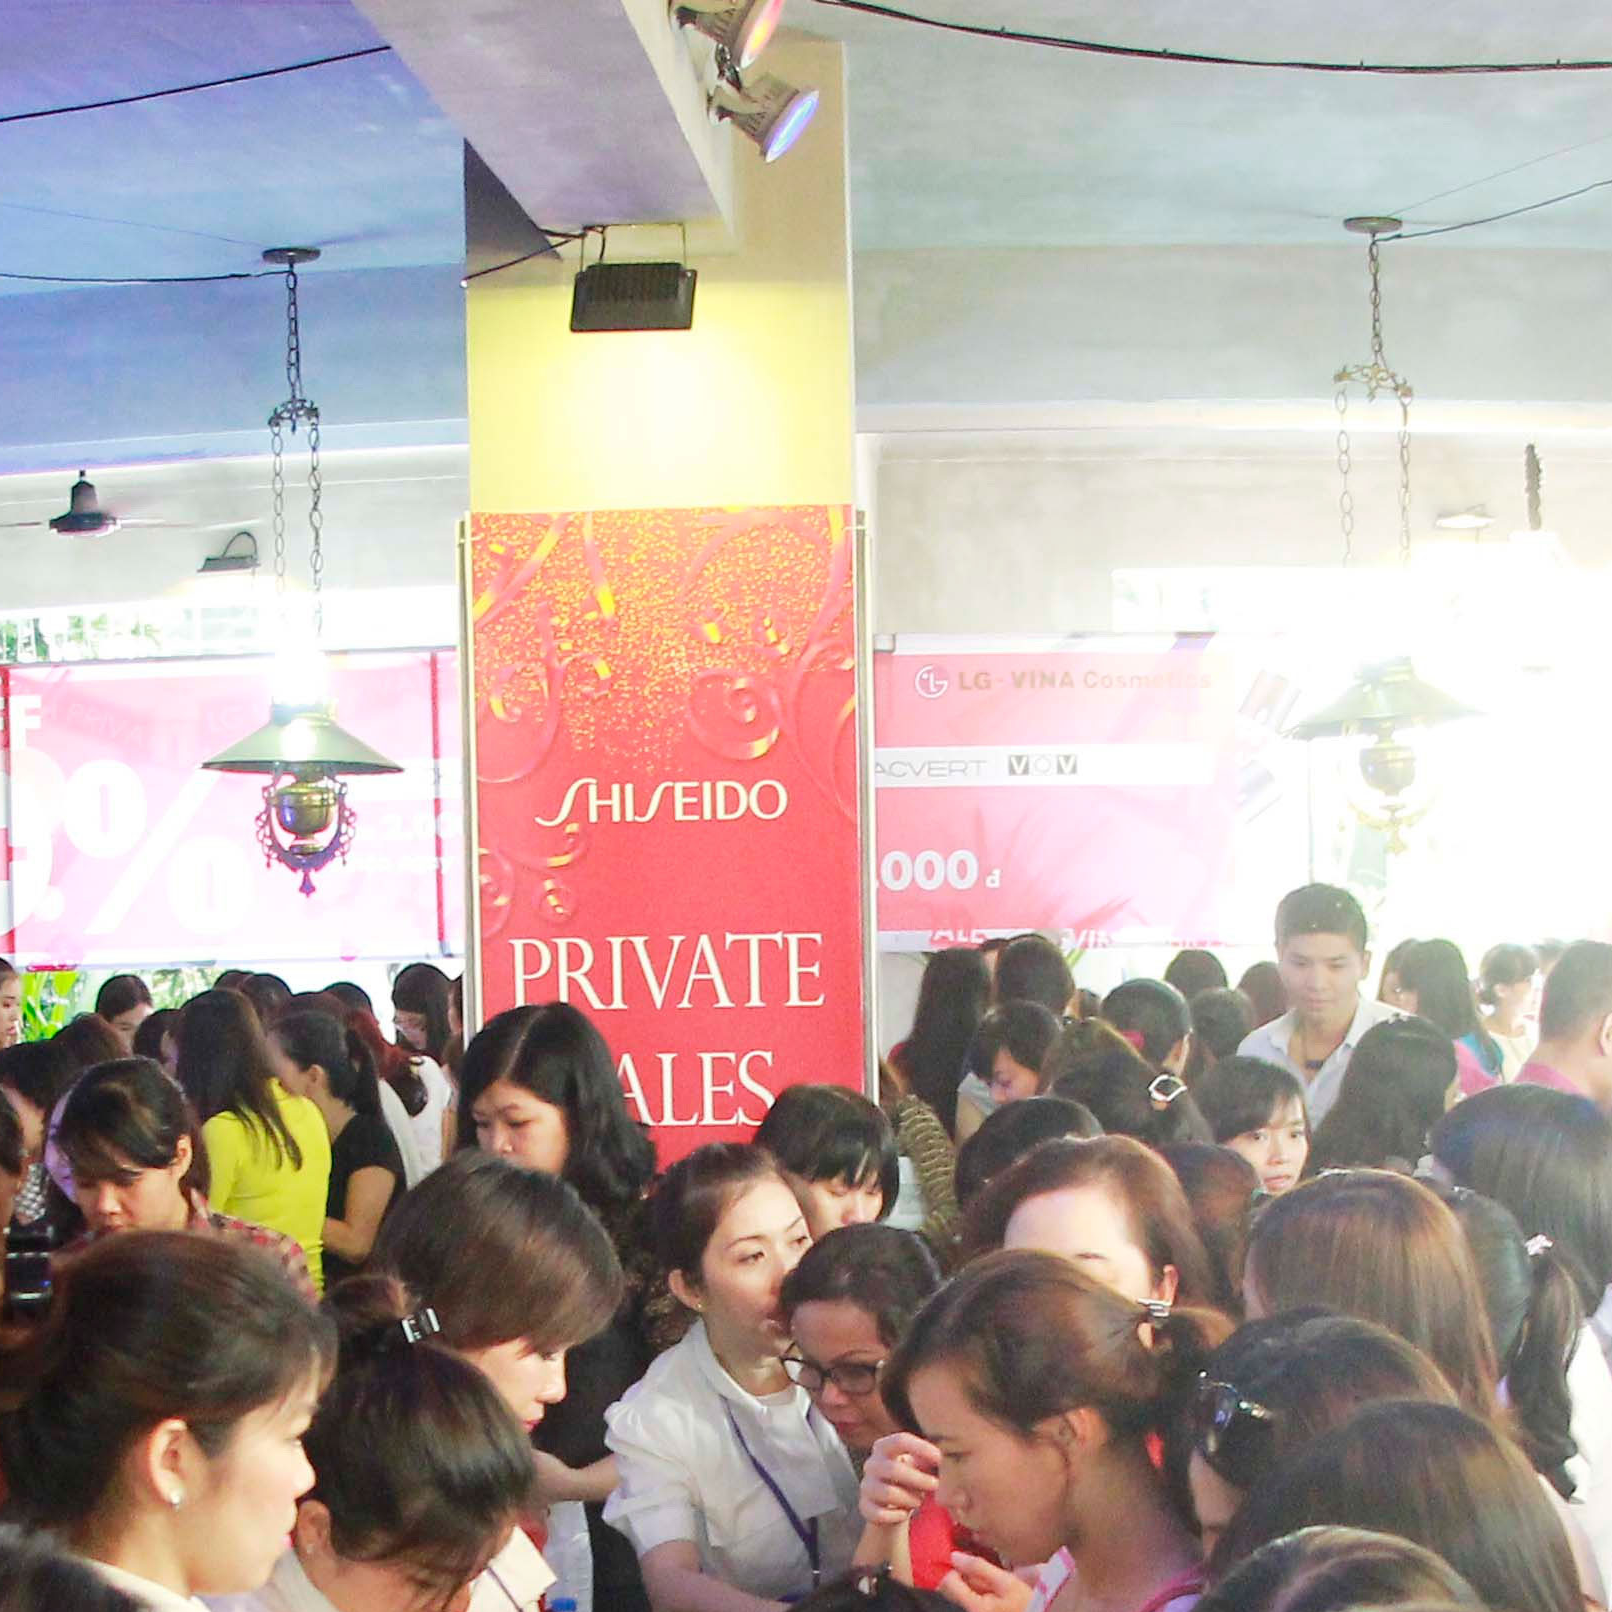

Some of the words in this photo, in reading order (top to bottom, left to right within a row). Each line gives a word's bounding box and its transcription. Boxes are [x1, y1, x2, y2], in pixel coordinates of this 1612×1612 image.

[1011, 669, 1075, 690] VINA
[874, 760, 987, 778] ACVERT
[534, 778, 788, 826] SHISEIDO
[875, 850, 979, 891] .000
[508, 931, 825, 1012] PRIVATE
[612, 1049, 776, 1128] ALES
